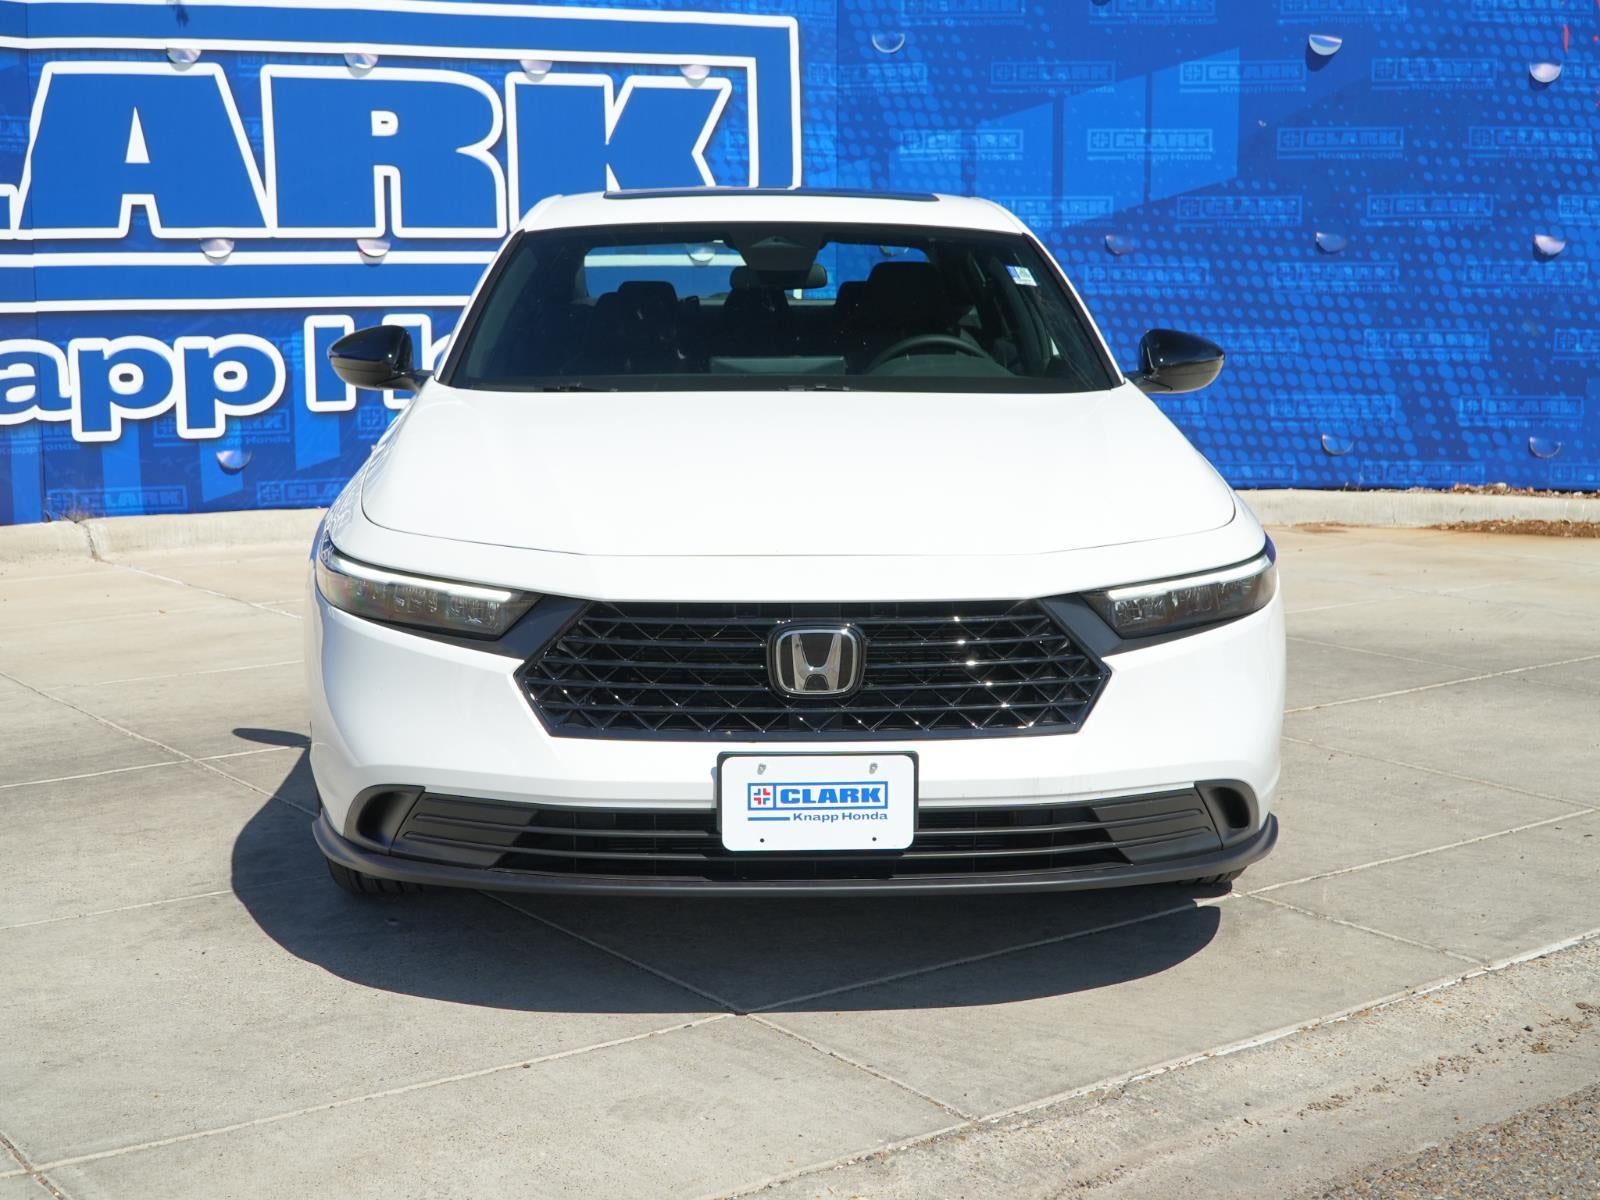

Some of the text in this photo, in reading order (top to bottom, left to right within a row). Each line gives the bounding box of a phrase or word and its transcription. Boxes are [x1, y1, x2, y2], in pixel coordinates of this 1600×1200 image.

[1116, 134, 1205, 146] CLARK
[0, 61, 733, 240] ARK
[780, 788, 881, 804] CLARK
[793, 812, 888, 823] Knapp Honda
